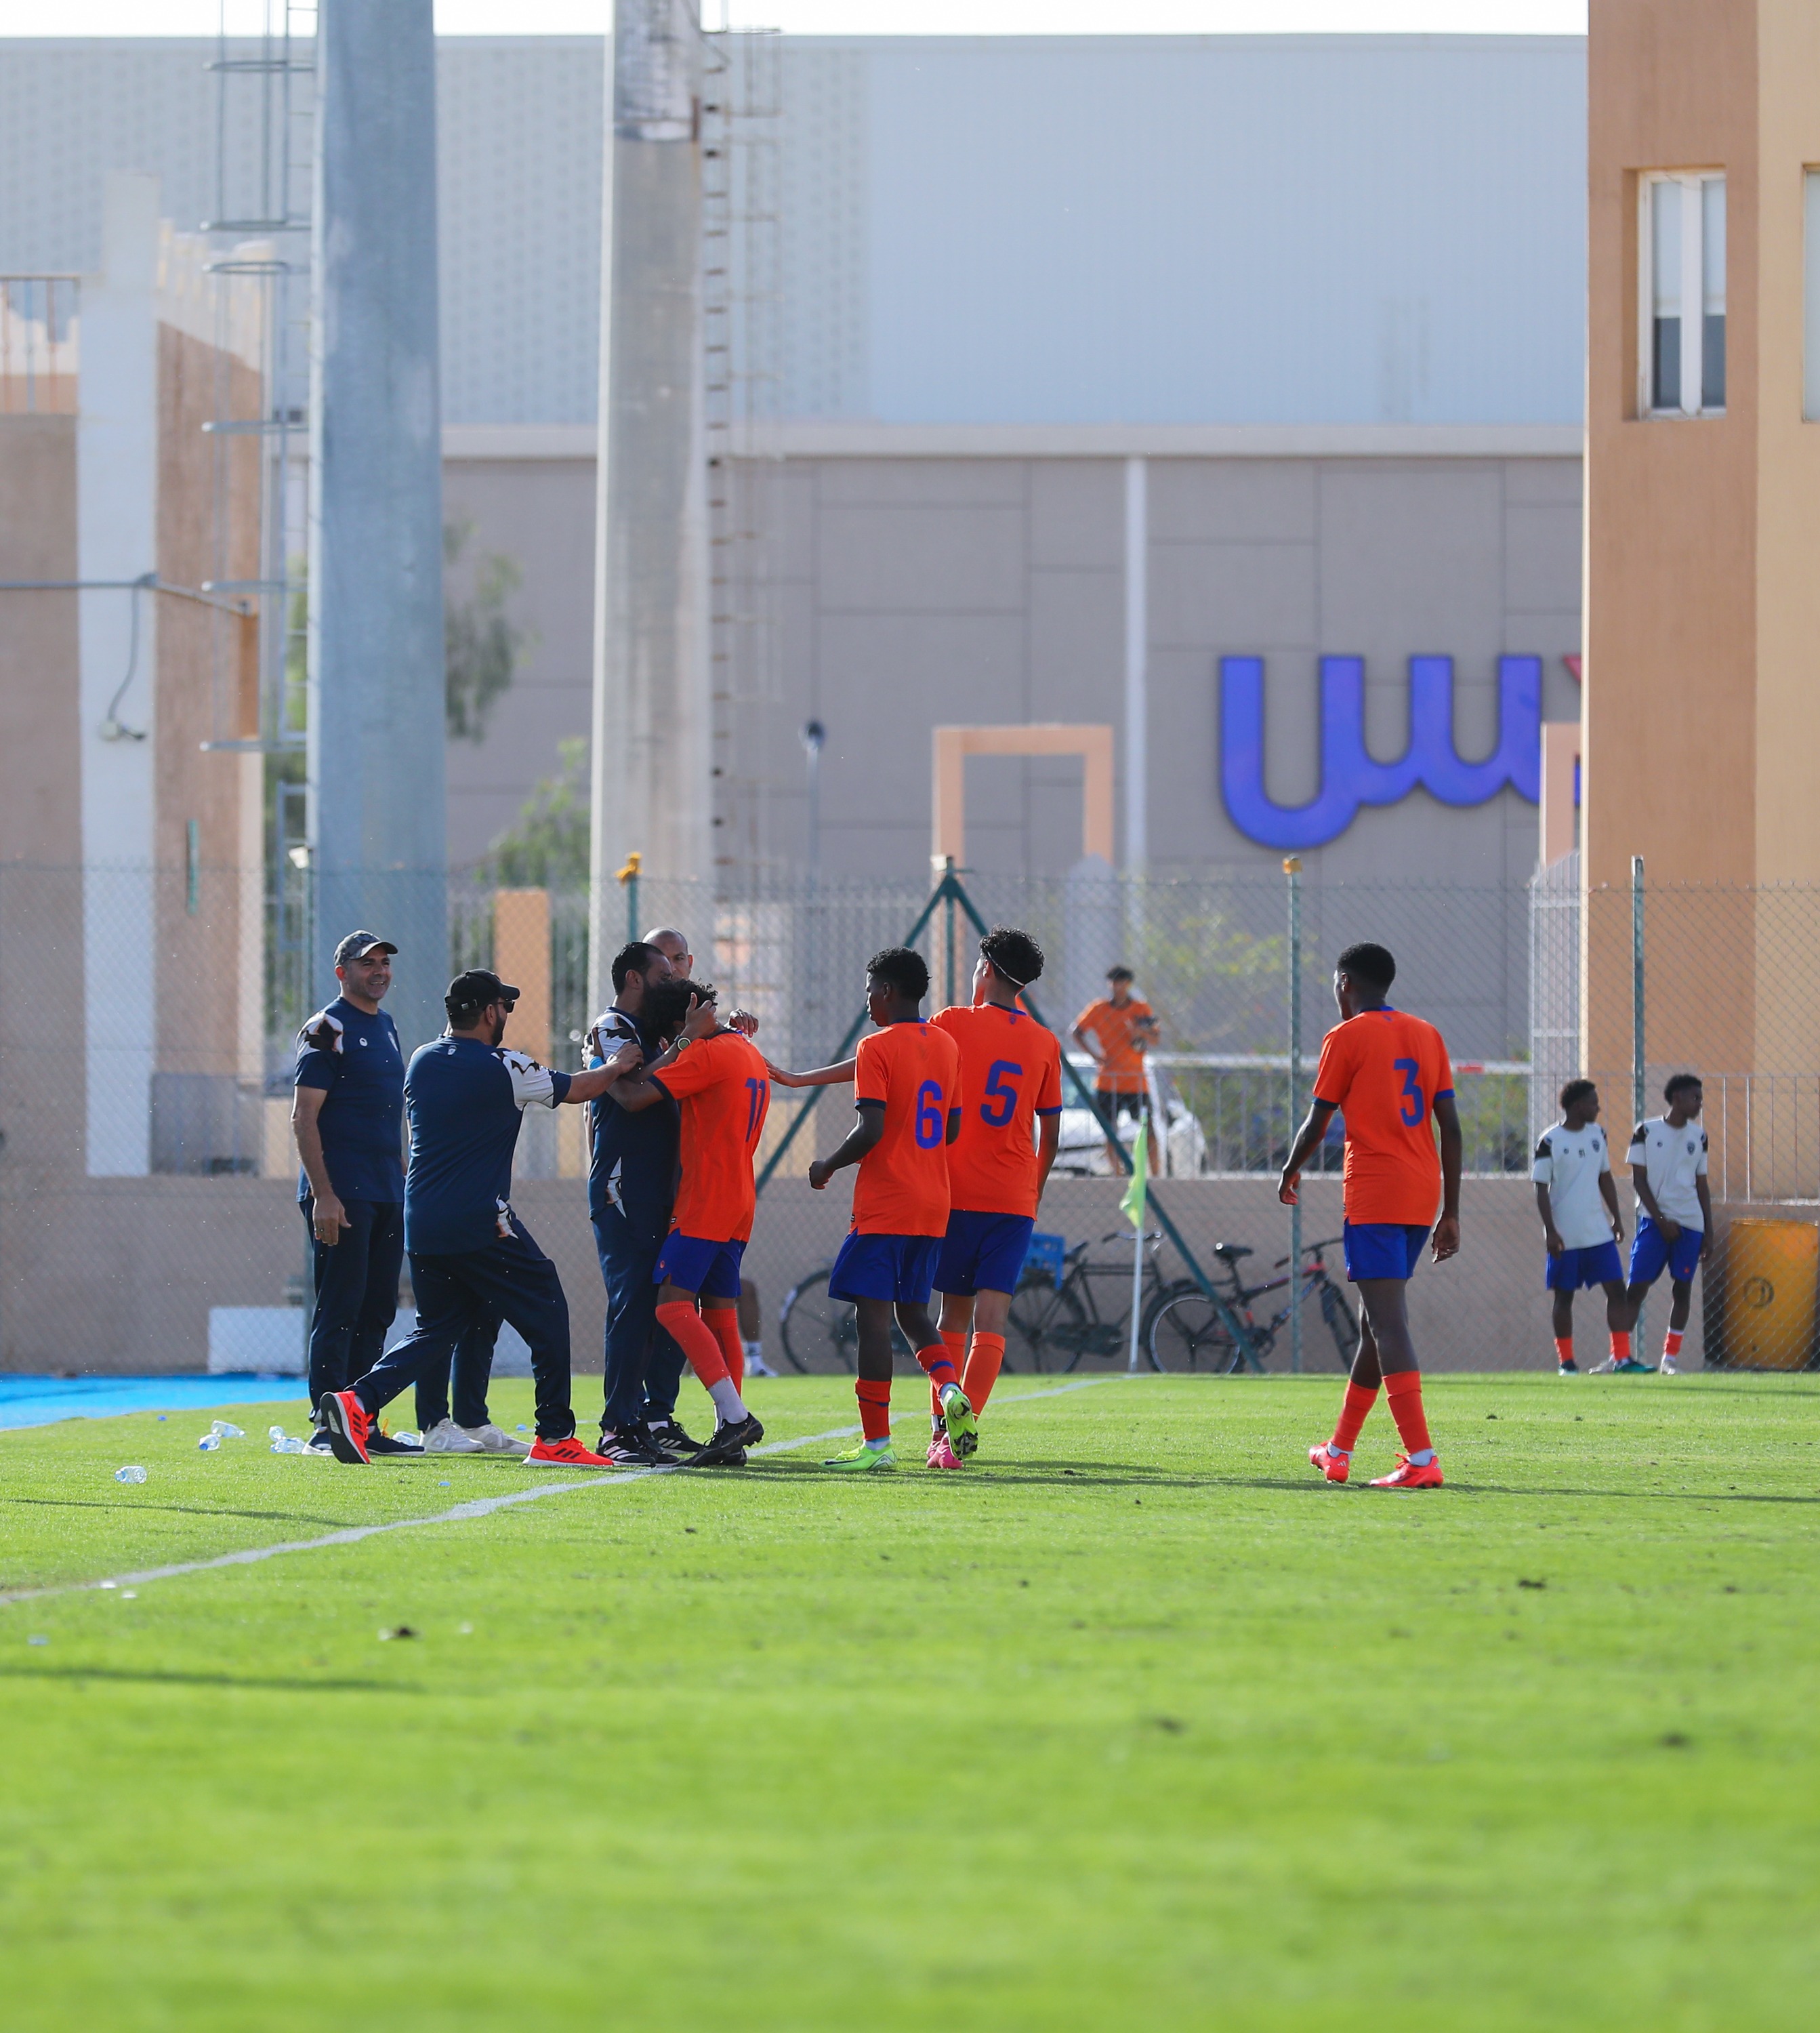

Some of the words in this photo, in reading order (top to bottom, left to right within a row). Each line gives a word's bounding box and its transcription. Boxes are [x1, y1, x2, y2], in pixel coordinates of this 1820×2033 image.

[745, 1077, 766, 1143] 11
[915, 1080, 943, 1149] 6
[980, 1059, 1023, 1127] 5
[1394, 1058, 1424, 1127] 3
